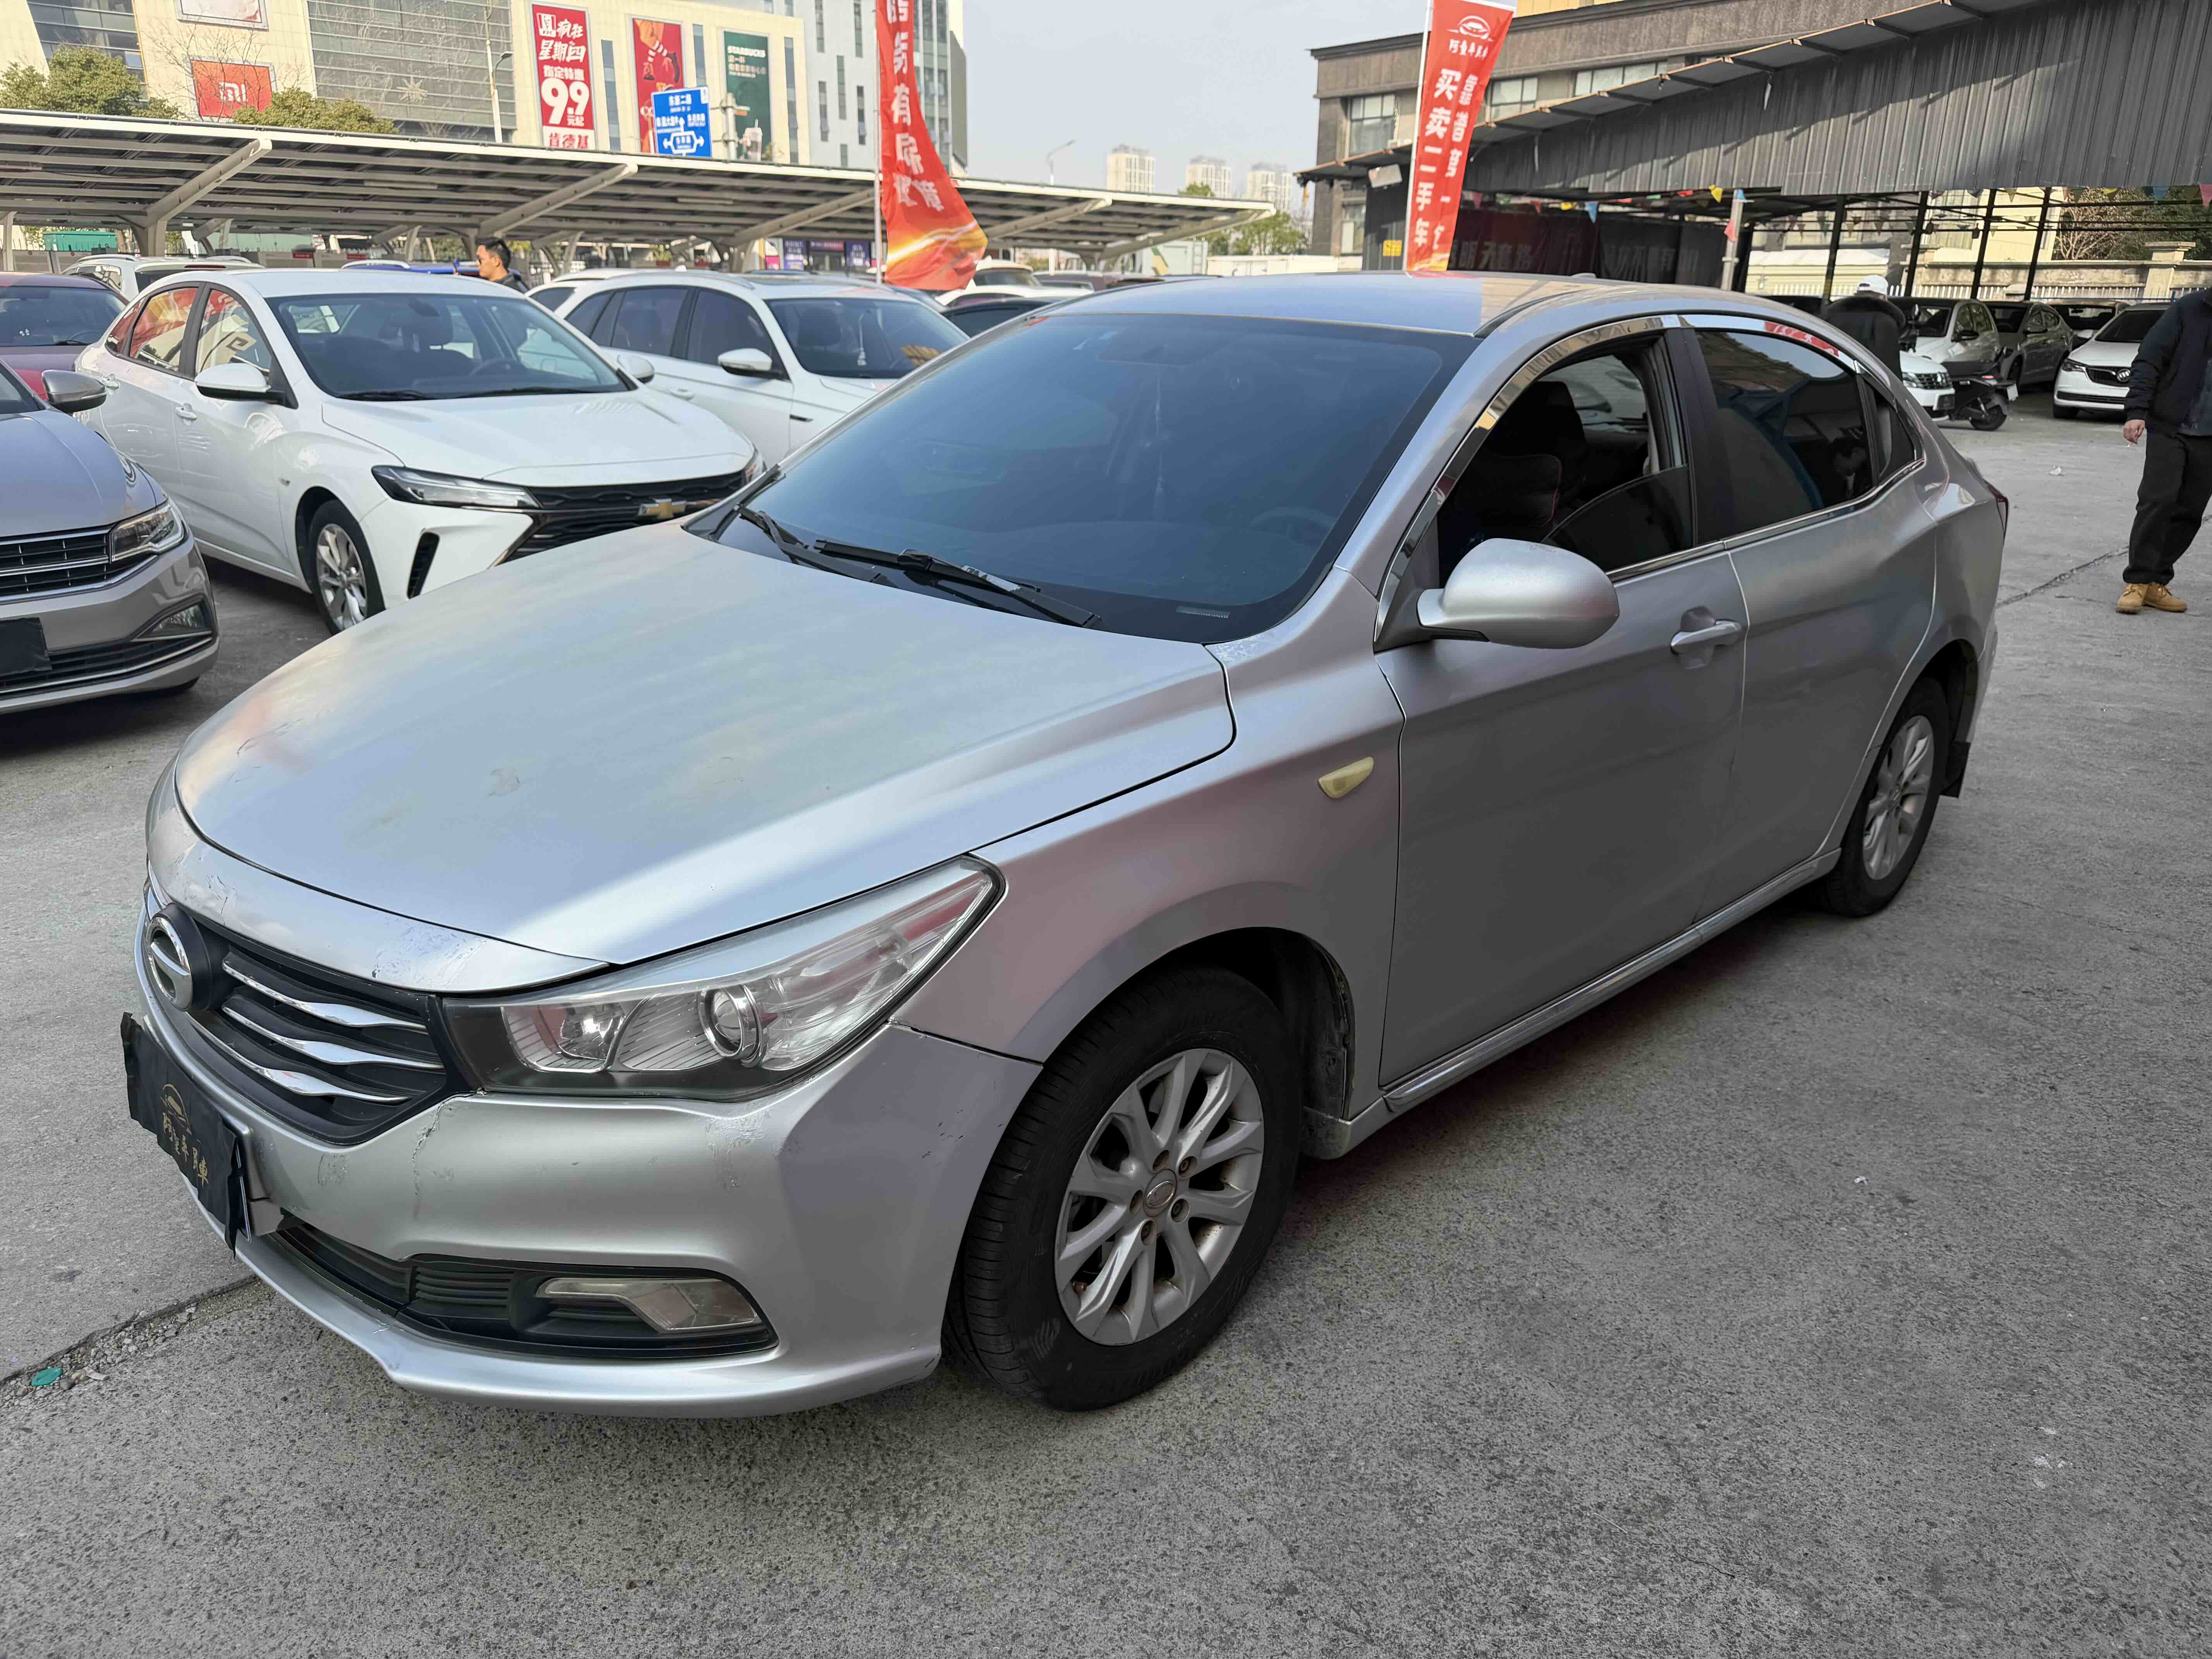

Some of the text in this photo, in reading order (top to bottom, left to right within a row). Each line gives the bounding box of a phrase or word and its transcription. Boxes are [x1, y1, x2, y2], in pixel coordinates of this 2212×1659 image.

[556, 19, 584, 39] 疯狂
[539, 40, 586, 63] 星期四
[541, 77, 590, 125] 9.9
[567, 115, 585, 127] 元起
[549, 133, 589, 149] 肯德基
[1414, 69, 1462, 247] 买卖二手车
